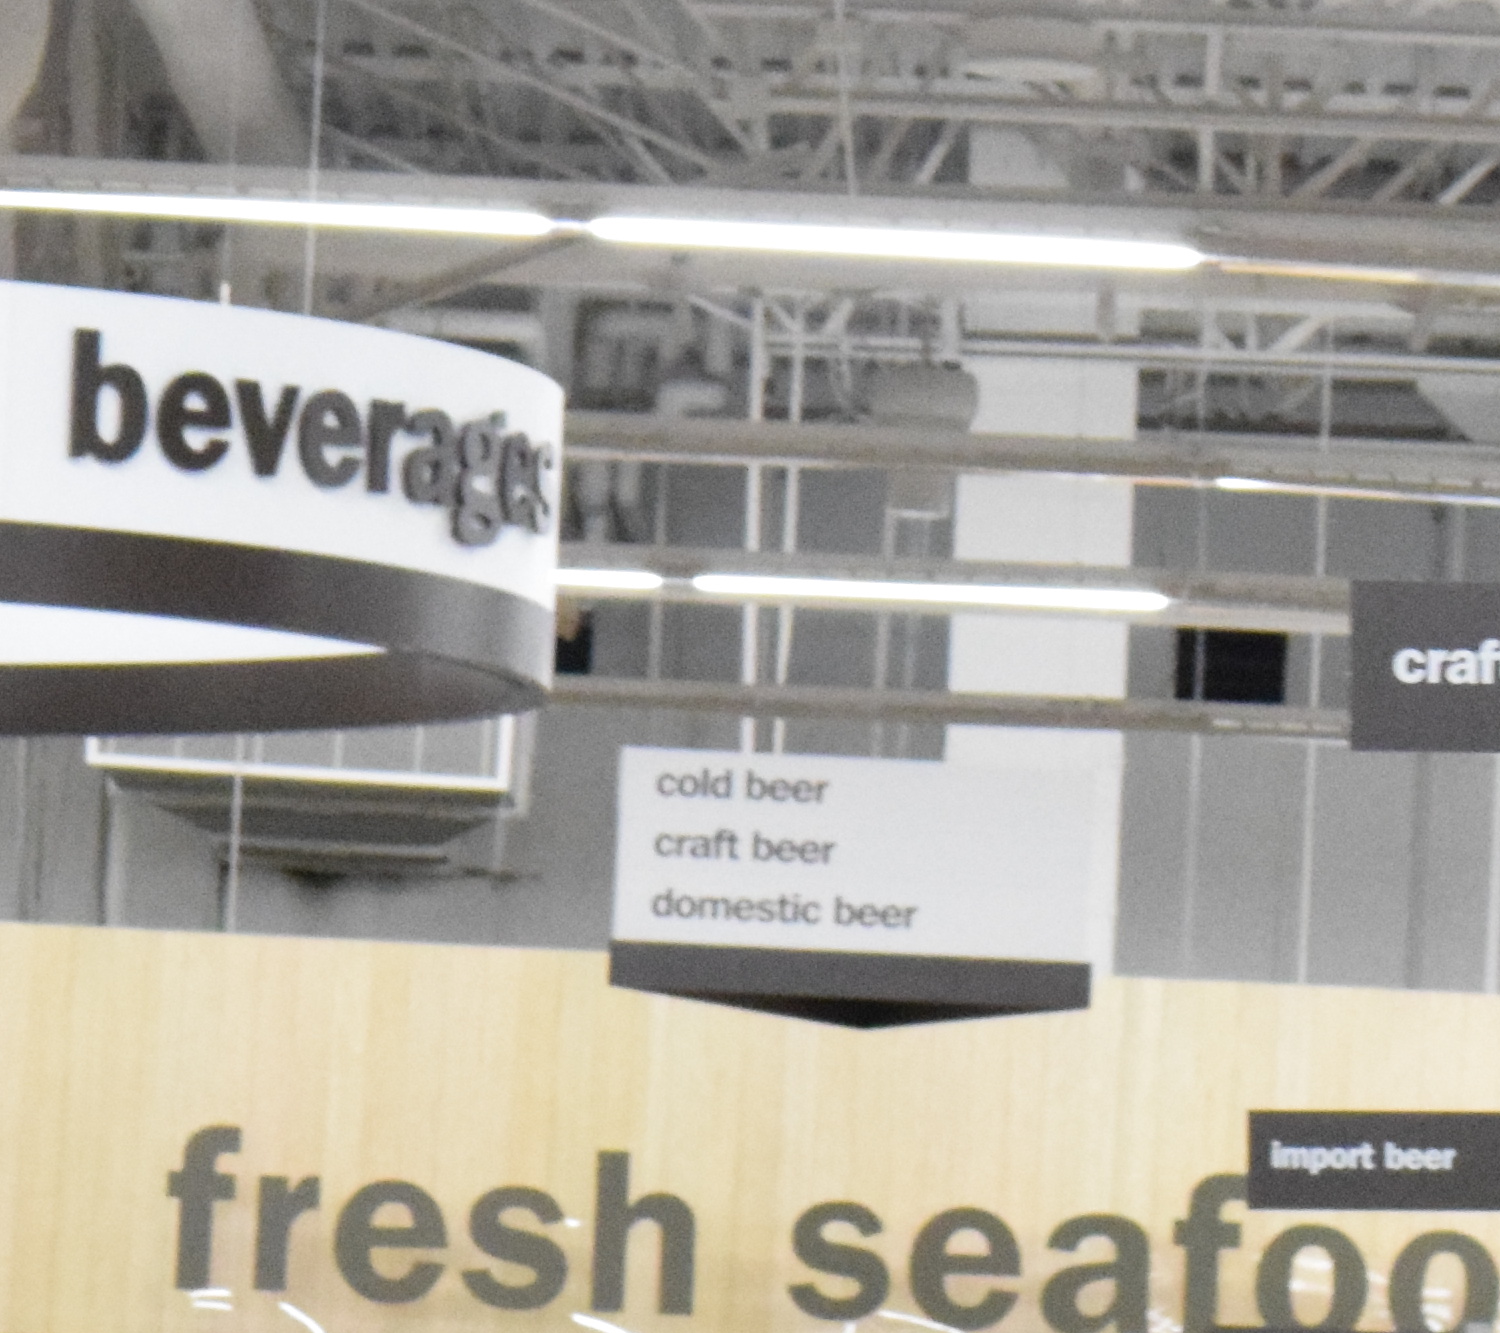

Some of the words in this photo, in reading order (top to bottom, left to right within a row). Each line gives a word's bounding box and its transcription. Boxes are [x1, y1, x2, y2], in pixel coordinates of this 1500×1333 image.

[67, 327, 554, 548] beverages
[656, 767, 734, 799] cold
[746, 769, 830, 803] beer
[654, 828, 740, 860] craft
[751, 830, 836, 864] beer
[651, 887, 824, 926] domestic
[833, 895, 919, 929] beer
[1270, 1139, 1375, 1176] import
[1383, 1140, 1458, 1172] beer
[166, 1124, 696, 1316] fresh
